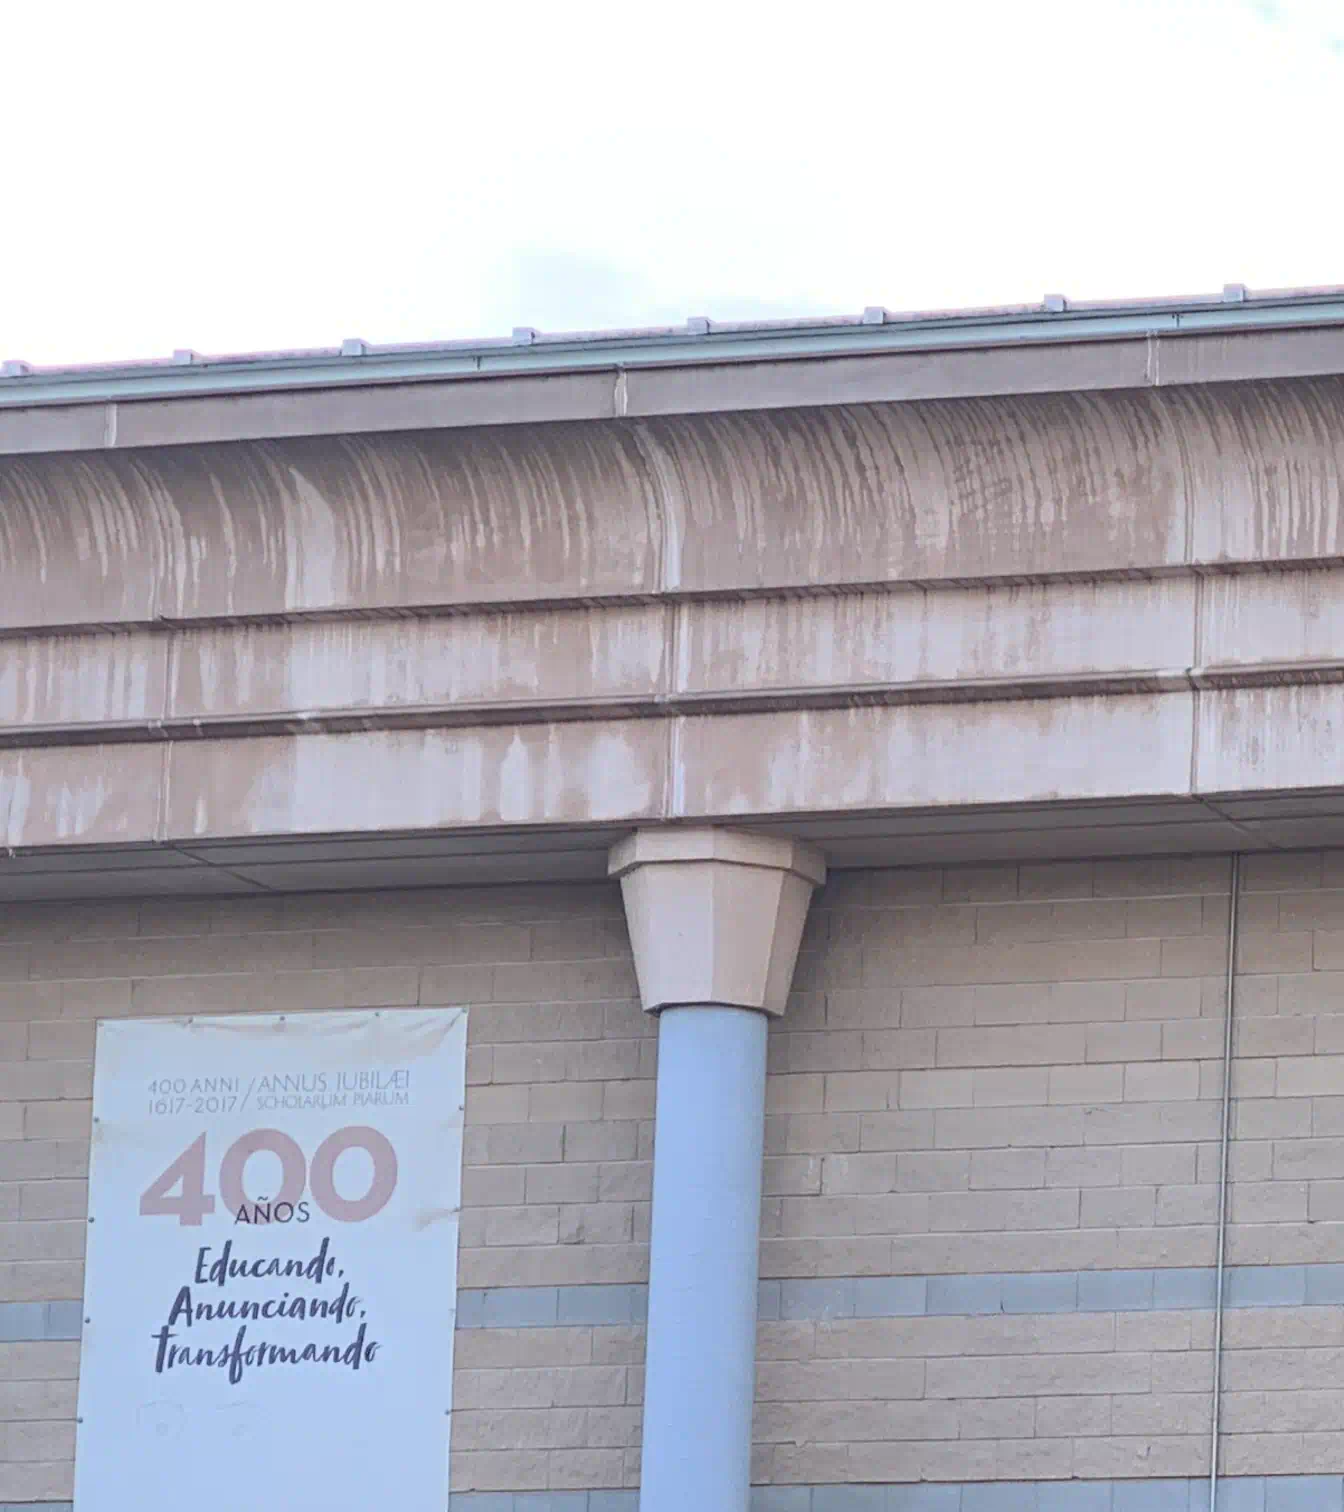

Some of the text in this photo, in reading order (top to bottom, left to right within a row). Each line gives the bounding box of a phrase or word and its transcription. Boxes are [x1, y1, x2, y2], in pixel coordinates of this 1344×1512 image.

[147, 1078, 187, 1096] 400
[190, 1076, 240, 1094] ANNI
[257, 1071, 328, 1093] ANNUS
[147, 1096, 238, 1116] 1617-2017
[138, 1125, 399, 1227] 400
[234, 1196, 311, 1226] AÑOS
[194, 1236, 345, 1287] Educando,
[167, 1282, 368, 1328] Anunciando,
[151, 1322, 383, 1385] Transformando
